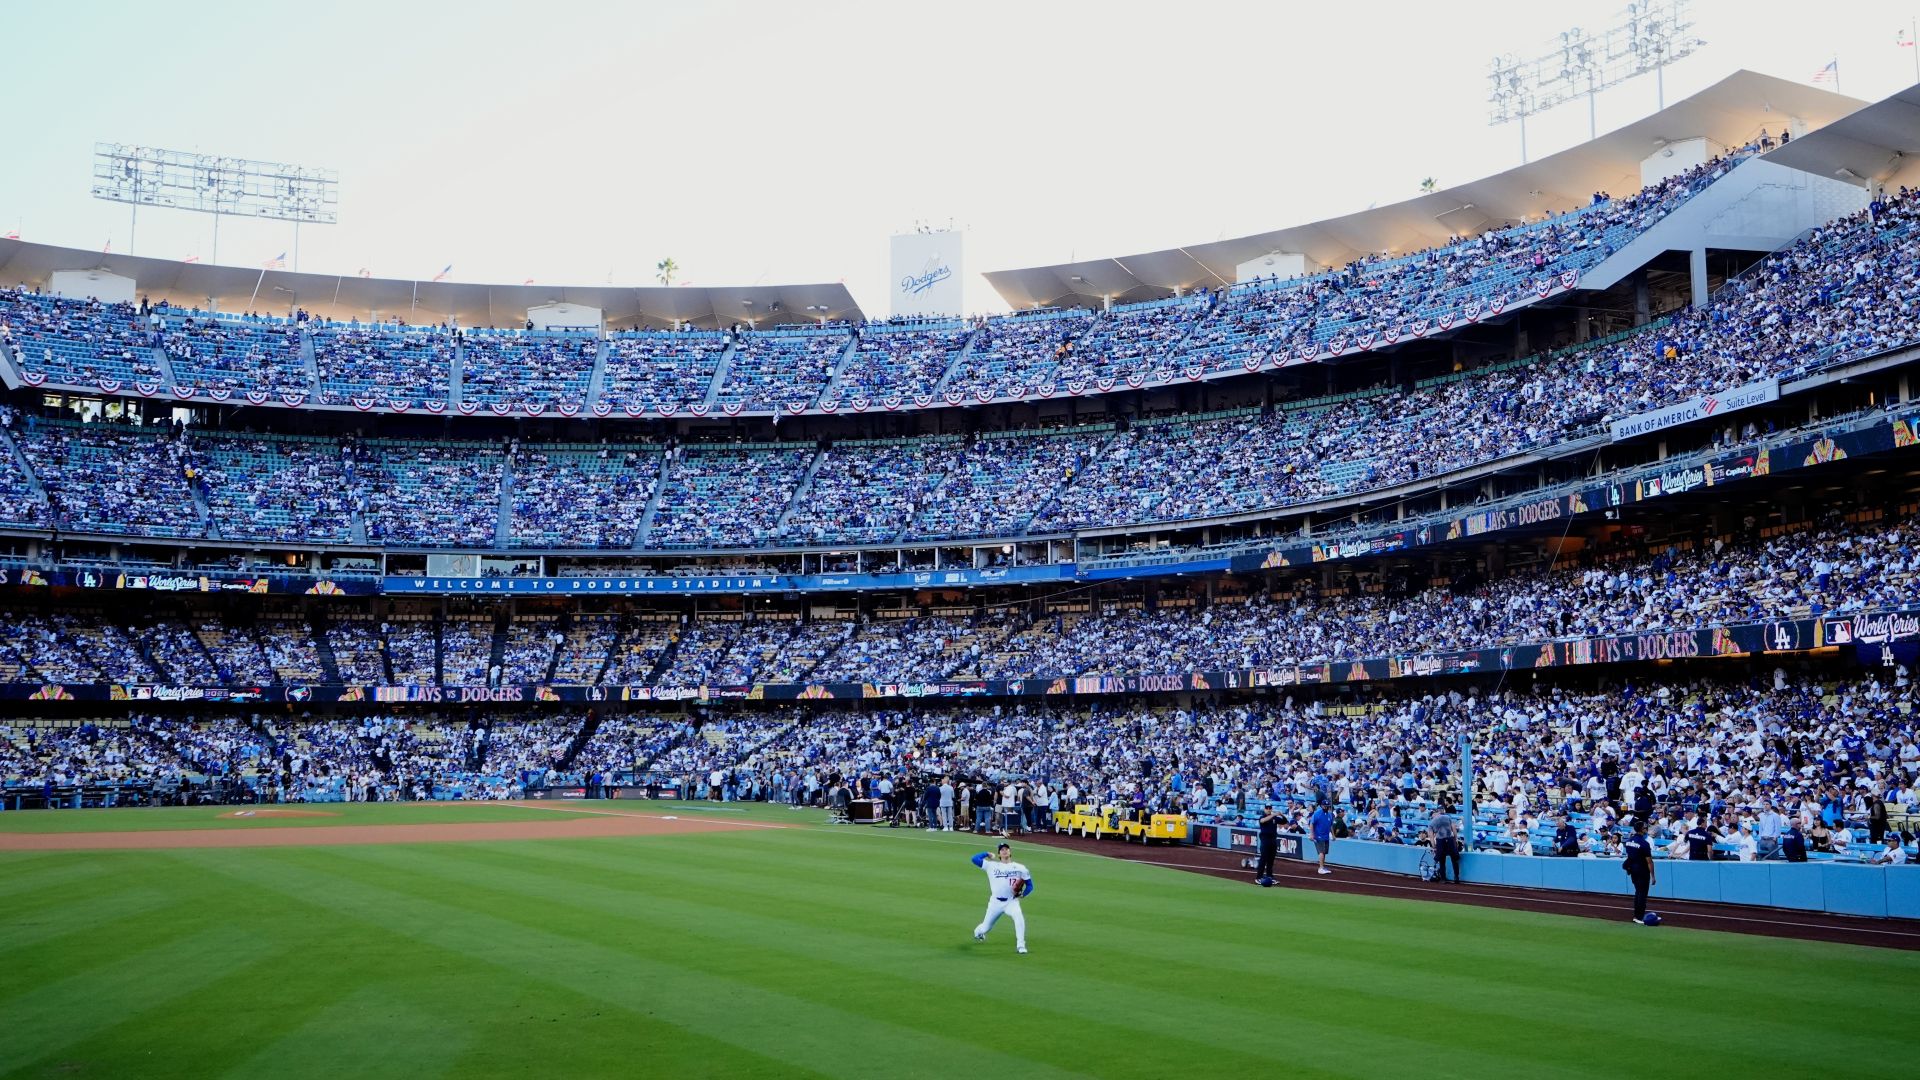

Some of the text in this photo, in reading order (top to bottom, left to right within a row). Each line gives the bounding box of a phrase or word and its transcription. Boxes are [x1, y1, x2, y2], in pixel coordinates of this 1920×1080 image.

[902, 265, 951, 293] Dodgers
[1726, 390, 1766, 411] Suite Level
[1619, 408, 1698, 438] BANK OF AMERICA
[1661, 469, 1704, 492] World Series
[1611, 484, 1620, 505] LA
[1519, 499, 1561, 525] DODGERS
[84, 572, 96, 587] LA
[149, 575, 198, 590] World Series
[414, 579, 762, 589] WELCOME TO DODGER STADIUM
[1774, 621, 1791, 650] LA
[1853, 612, 1919, 642] World Series
[1637, 631, 1699, 661] DODGERS
[1881, 645, 1895, 667] LA
[898, 682, 921, 695] World
[1139, 675, 1184, 692] DODGERS
[152, 686, 204, 700] World Series
[461, 687, 523, 702] DODGERS
[591, 687, 602, 701] LA
[652, 686, 678, 699] World
[993, 870, 1020, 880] Dodgers
[1009, 878, 1017, 887] 17
